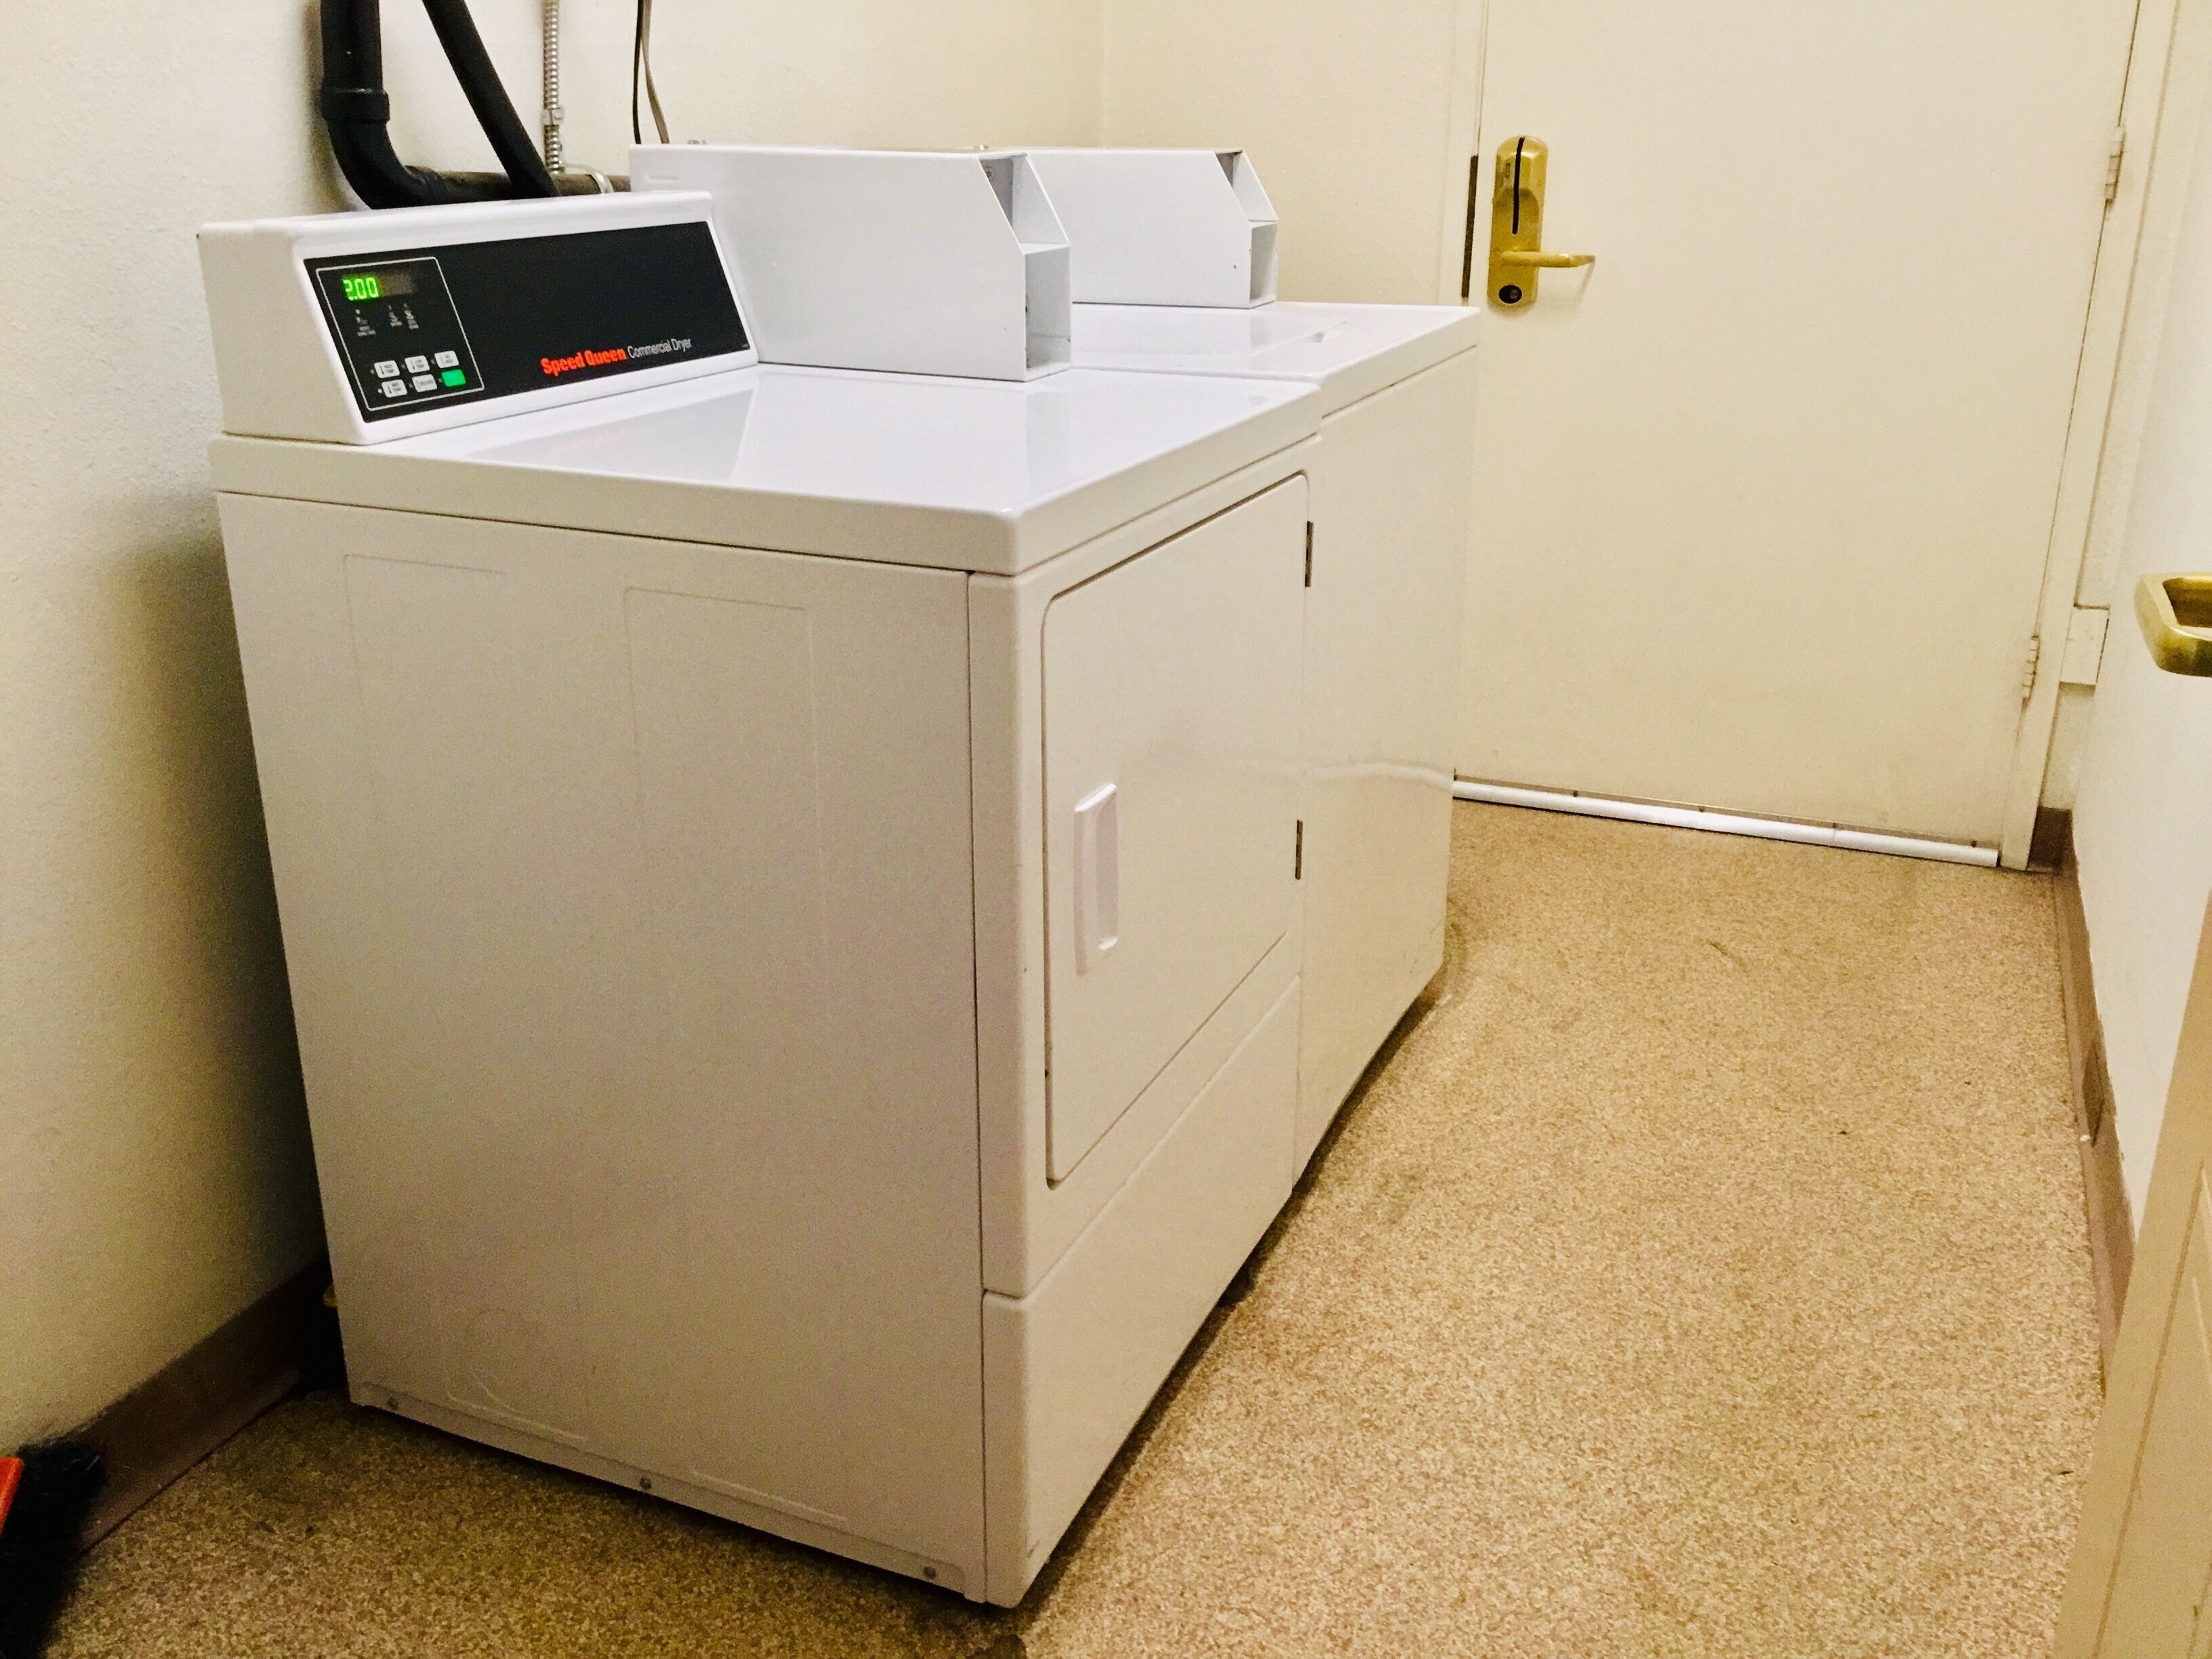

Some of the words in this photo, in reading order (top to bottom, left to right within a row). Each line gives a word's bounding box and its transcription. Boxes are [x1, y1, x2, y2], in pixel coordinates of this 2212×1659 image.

[343, 277, 379, 300] 2.00
[541, 352, 586, 376] Speed
[584, 348, 628, 366] Queen
[628, 340, 672, 359] Commercial
[671, 338, 692, 352] Dryer
